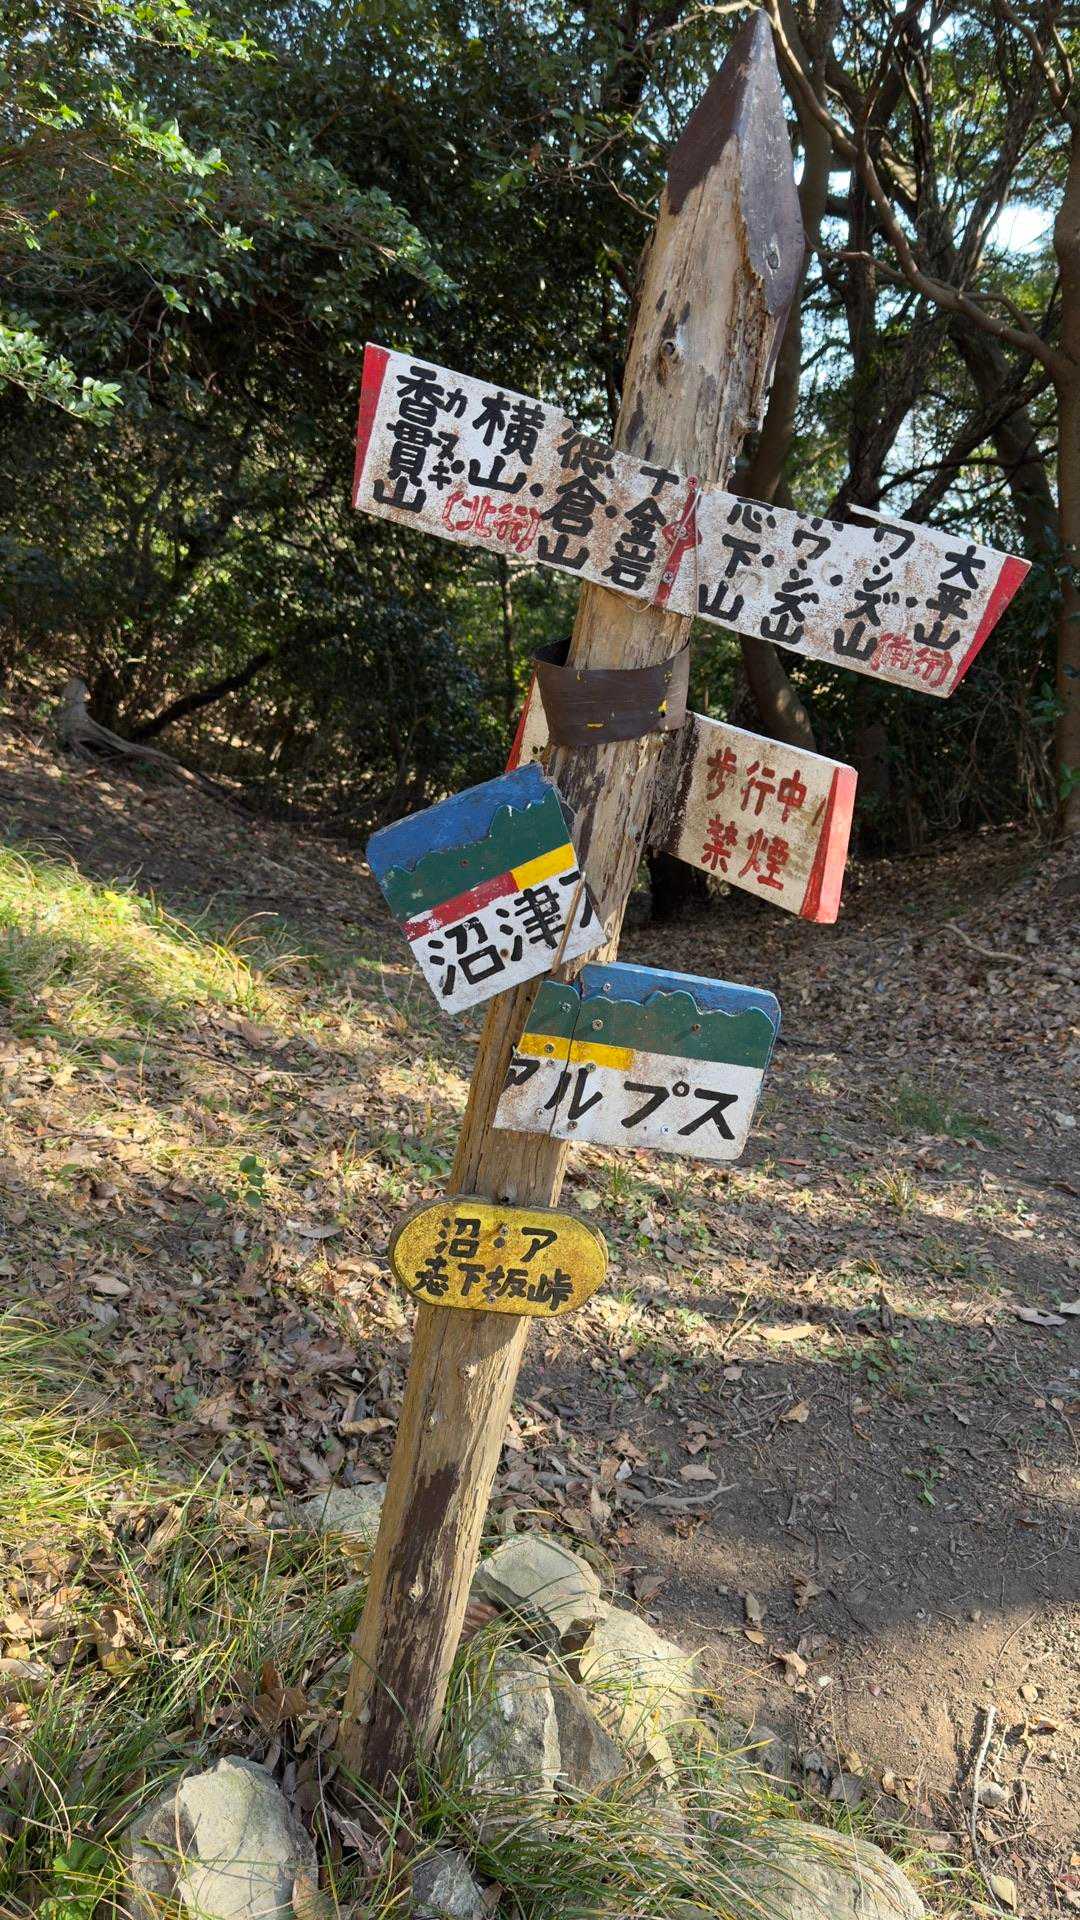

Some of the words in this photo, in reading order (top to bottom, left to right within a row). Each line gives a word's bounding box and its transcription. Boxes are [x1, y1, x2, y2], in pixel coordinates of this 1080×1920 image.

[373, 365, 449, 513] 香貫山
[468, 391, 546, 494] 横山
[914, 545, 986, 649] 大平山
[706, 747, 807, 823] 歩行中
[701, 813, 790, 891] 禁煙
[412, 1256, 575, 1311] 志下坂峠
